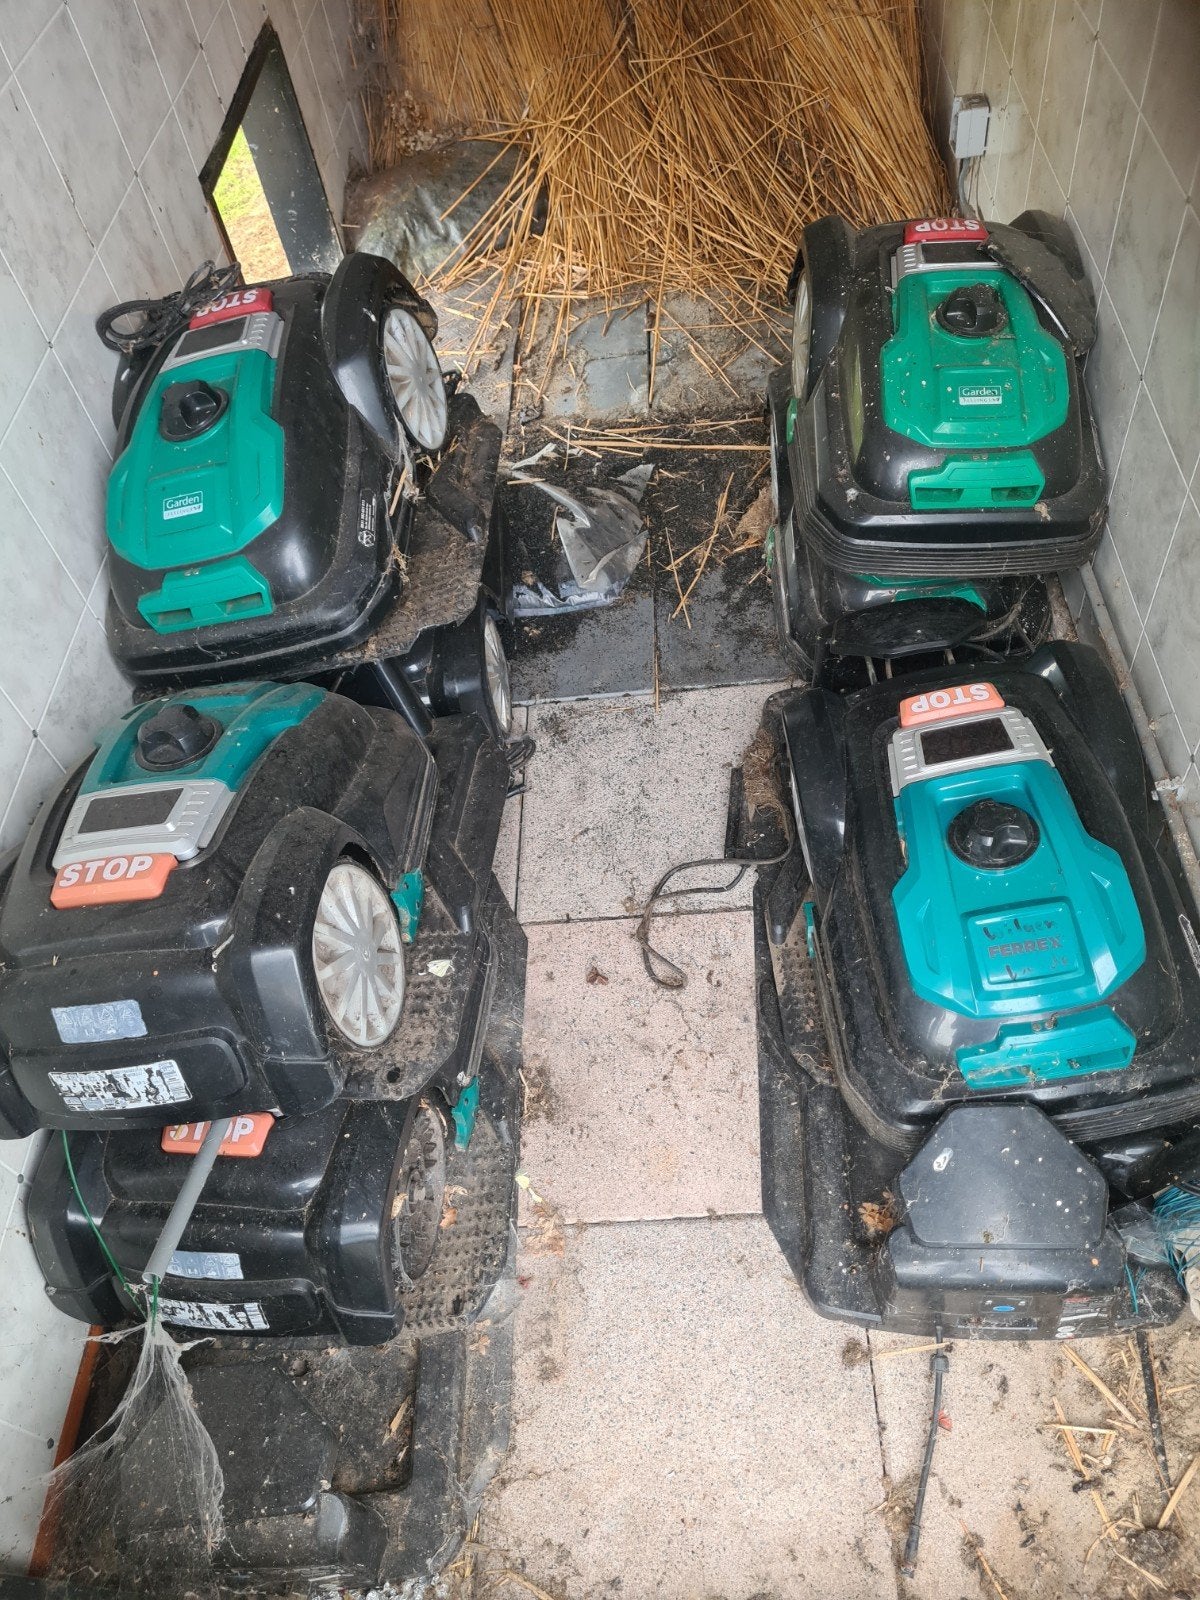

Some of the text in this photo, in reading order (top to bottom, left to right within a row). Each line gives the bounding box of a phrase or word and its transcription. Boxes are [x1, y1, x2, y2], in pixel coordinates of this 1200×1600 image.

[914, 219, 981, 232] STOP
[962, 387, 998, 396] Garden
[166, 495, 200, 509] Garden
[911, 683, 990, 713] STOP
[59, 855, 154, 888] STOP
[987, 935, 1062, 959] FERREX
[169, 1117, 255, 1142] SP
